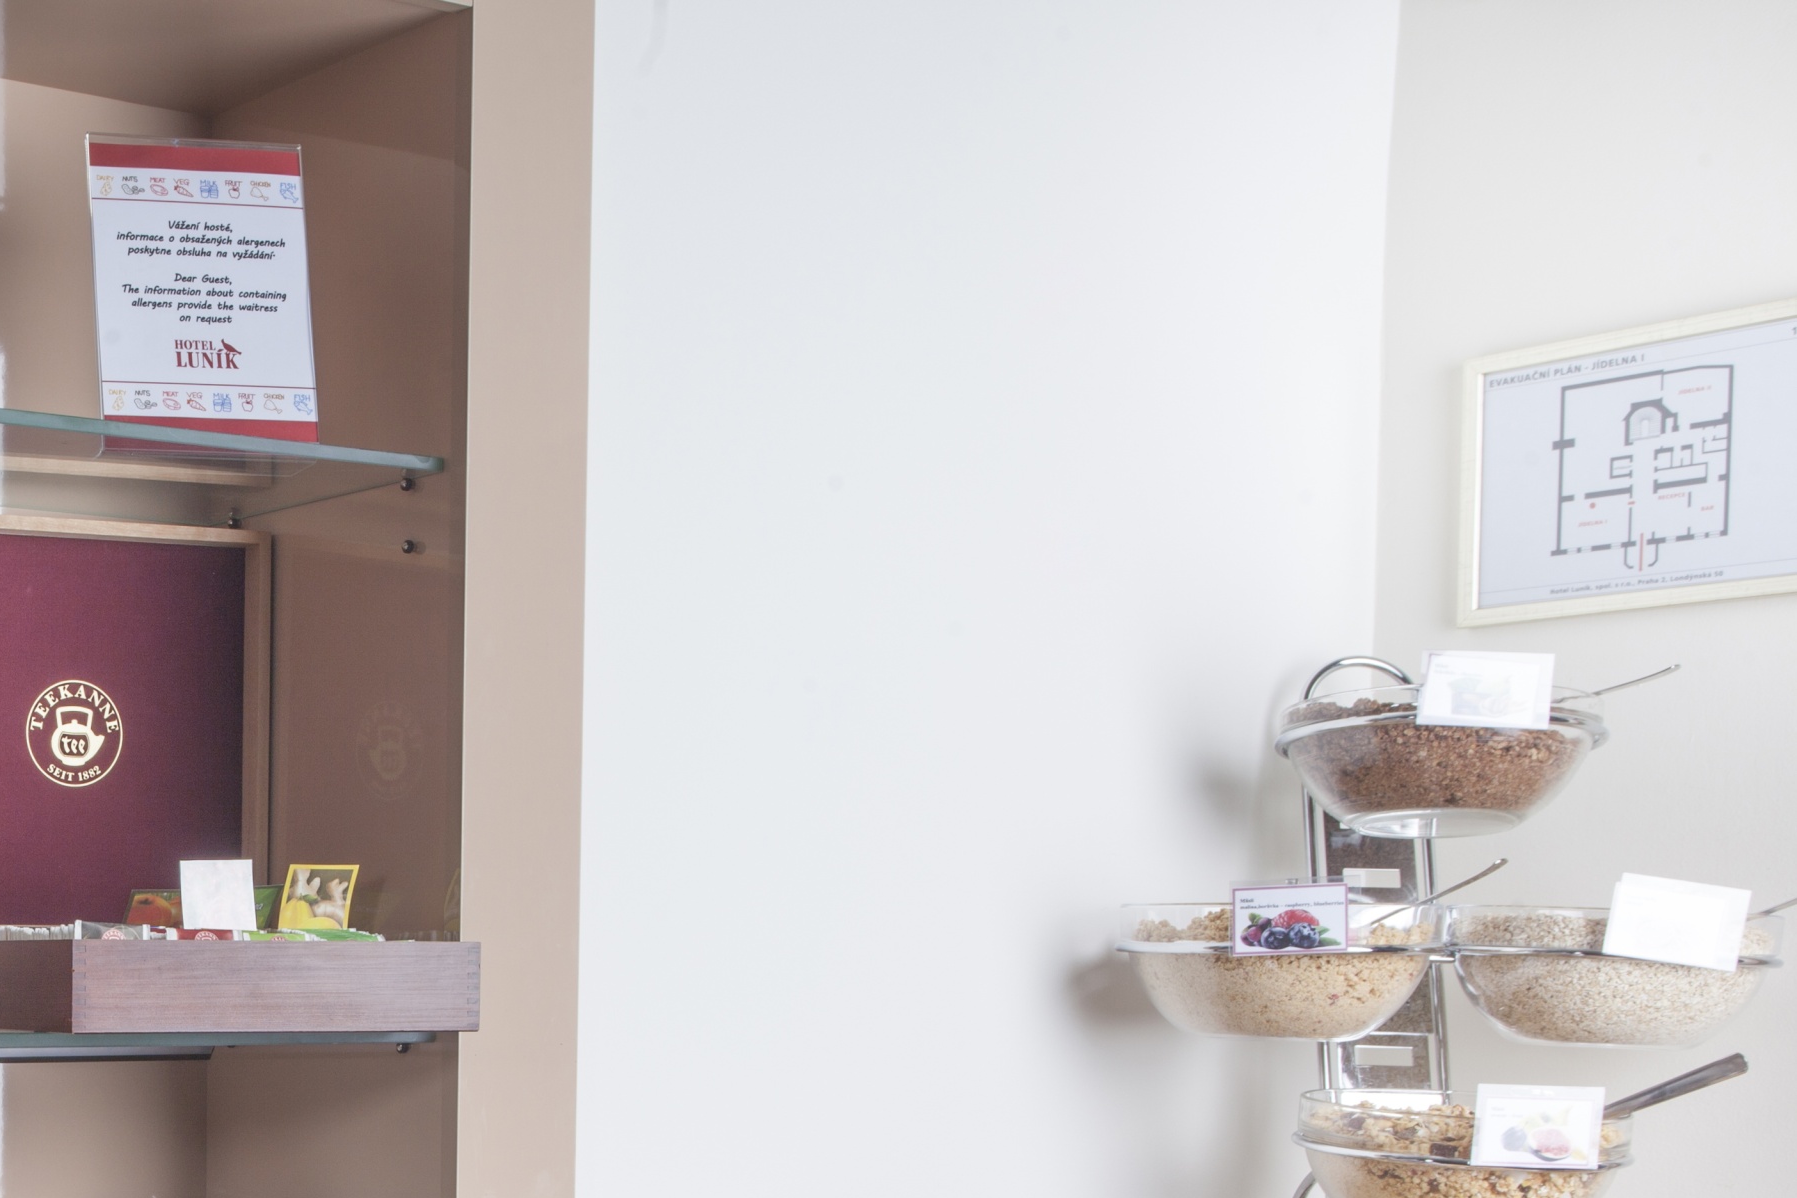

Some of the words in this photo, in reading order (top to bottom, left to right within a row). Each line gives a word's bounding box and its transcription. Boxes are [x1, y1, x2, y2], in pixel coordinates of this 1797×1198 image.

[121, 175, 139, 183] NUTS
[150, 176, 167, 184] MEAT
[173, 178, 190, 186] VEG
[168, 220, 200, 231] Vážení
[204, 222, 233, 233] hosté,
[116, 231, 164, 242] informace
[179, 234, 233, 247] obsažených
[236, 237, 286, 249] alergenech
[127, 245, 172, 257] poskytne
[176, 247, 212, 257] obsluha
[174, 273, 197, 283] Dear
[201, 273, 232, 286] Guest,
[122, 283, 140, 295] The
[144, 285, 201, 297] information
[206, 287, 234, 298] about
[238, 289, 287, 302] containing
[131, 297, 173, 310] allergens
[176, 300, 213, 311] provide
[217, 301, 234, 311] the
[238, 303, 278, 313] waitress
[179, 314, 192, 323] on
[196, 315, 232, 326] request
[174, 339, 216, 351] HOTEL
[175, 348, 240, 370] LUNÍK
[1489, 367, 1551, 388] EVAKUAČNÍ
[1553, 363, 1582, 376] PLÁN
[1591, 354, 1637, 371] JÍDELNA
[134, 389, 151, 397] NUTS
[162, 390, 179, 398] MEAT
[186, 391, 203, 400] VEG
[30, 684, 120, 733] TEEKANNE
[47, 763, 75, 782] SEIT
[77, 765, 102, 781] 1882
